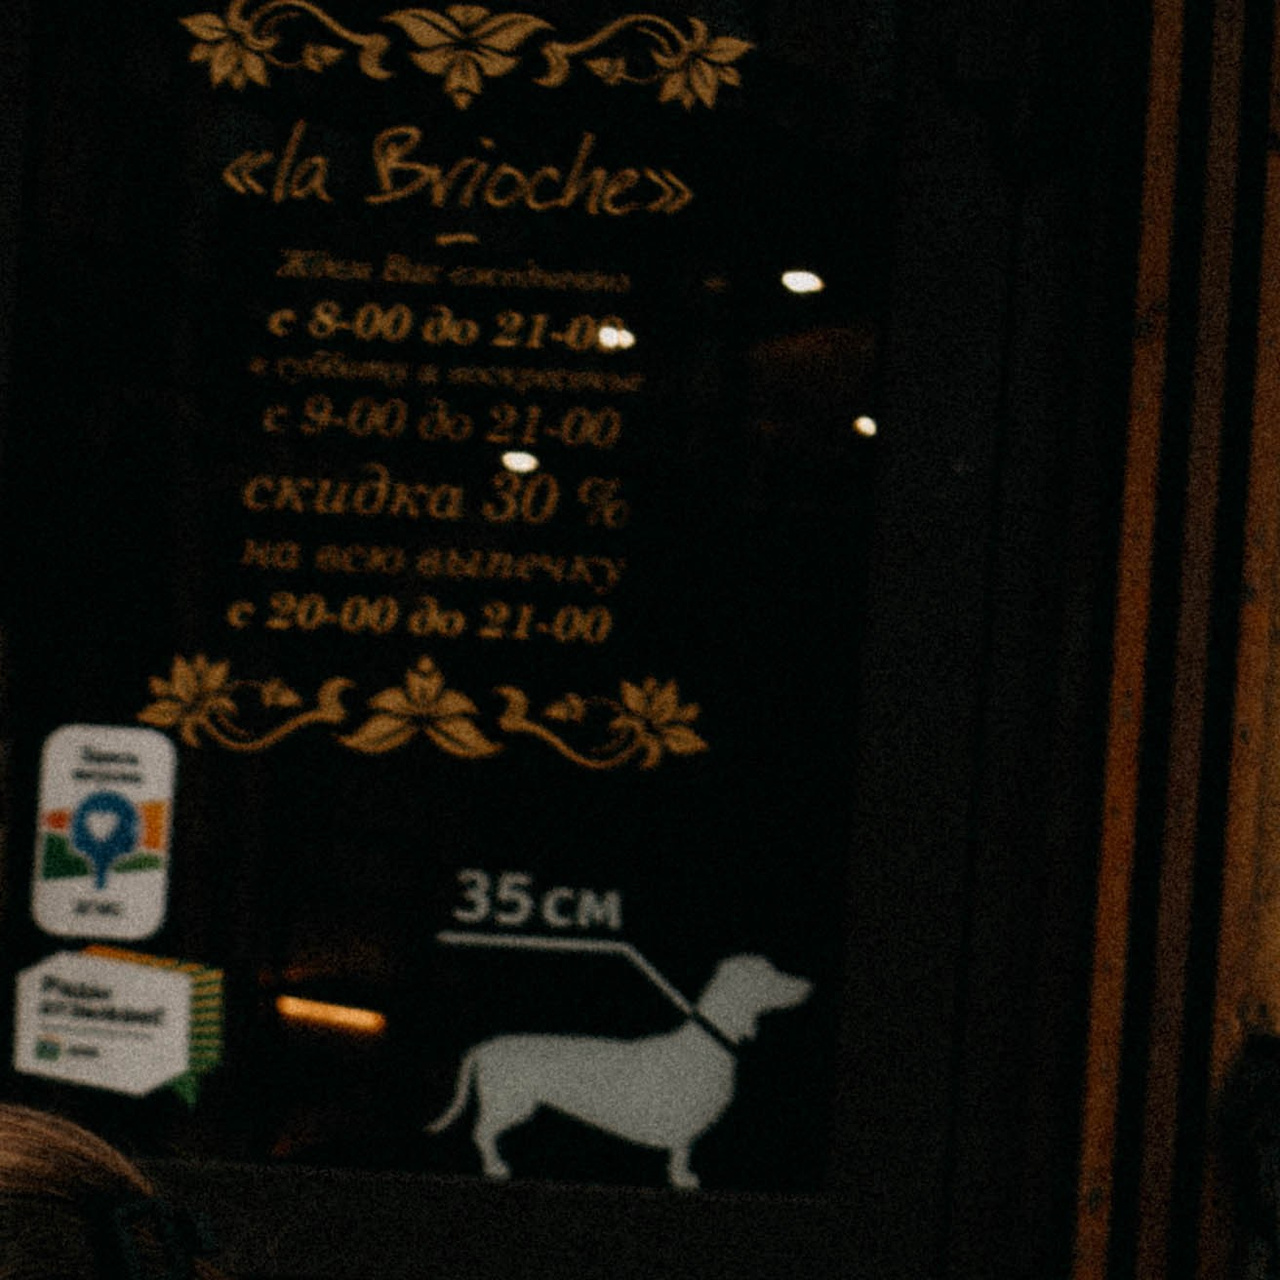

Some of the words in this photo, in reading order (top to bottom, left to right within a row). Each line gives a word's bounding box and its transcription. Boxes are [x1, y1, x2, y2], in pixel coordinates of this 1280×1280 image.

[308, 302, 412, 341] 8-00
[422, 306, 479, 344] до
[301, 395, 407, 437] 9-00
[417, 397, 472, 441] до
[486, 404, 621, 446] 21-00
[243, 463, 463, 520] скидка
[482, 470, 559, 523] 30
[266, 593, 399, 633] 20-00
[409, 596, 465, 636] до
[479, 602, 612, 643] 21-00
[454, 870, 534, 925] 35
